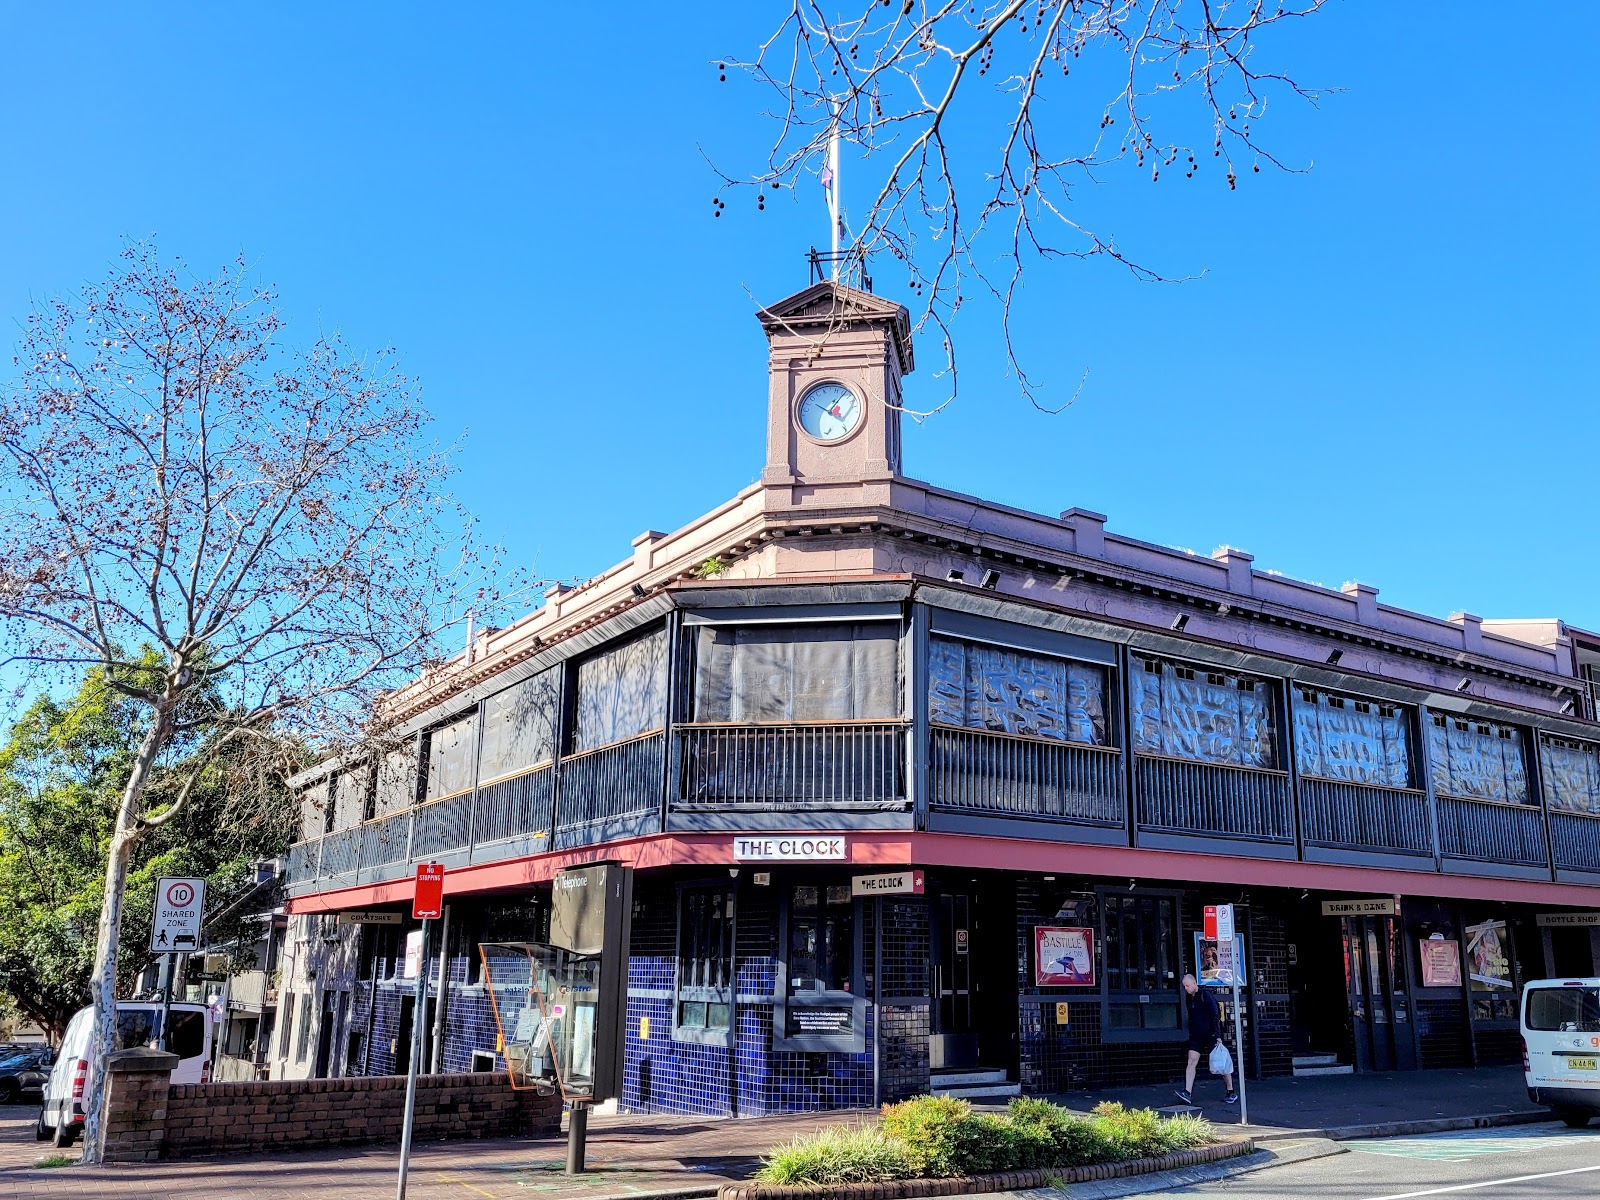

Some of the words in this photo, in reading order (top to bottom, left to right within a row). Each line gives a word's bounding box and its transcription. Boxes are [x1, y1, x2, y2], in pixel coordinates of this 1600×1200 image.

[738, 841, 773, 856] THE
[778, 840, 841, 856] CLOCK
[561, 874, 588, 892] Telephone
[861, 878, 877, 890] THE
[878, 876, 903, 889] CLOCK
[174, 889, 188, 901] 10
[1364, 903, 1387, 911] DINE
[161, 910, 195, 918] SHARED
[1577, 915, 1598, 923] SHOP
[166, 919, 188, 927] ZONE
[1043, 936, 1082, 949] BASTILLE
